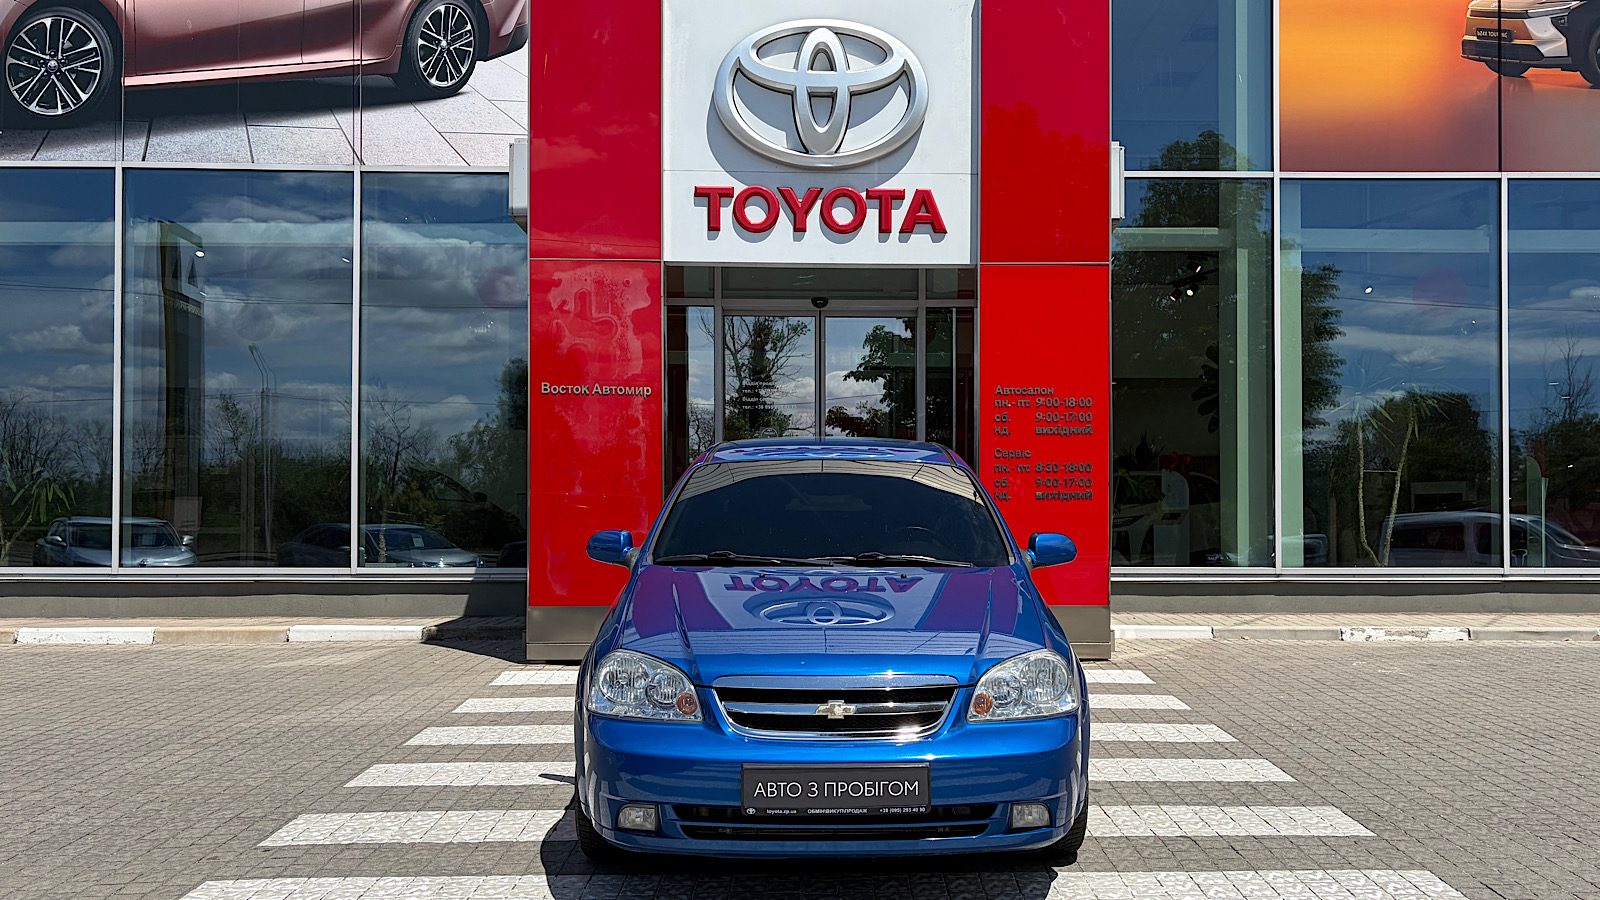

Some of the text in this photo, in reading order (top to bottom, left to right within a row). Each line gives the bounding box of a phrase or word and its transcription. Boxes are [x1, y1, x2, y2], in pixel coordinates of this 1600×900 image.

[694, 185, 948, 234] TOYOTA
[541, 382, 652, 399] Восток Автомир
[994, 384, 1055, 395] Автосалон
[1035, 397, 1093, 408] 9:00-18:00
[994, 411, 1093, 422] сб. 9:00-17:00
[994, 424, 1093, 436] нд. вихідний
[994, 448, 1031, 460] Сервіс
[1035, 462, 1093, 473] 8:30-18:00
[994, 477, 1093, 488] сб. 9:00-17:00
[1035, 489, 1093, 501] вихідний
[753, 781, 919, 798] АВТО З ПРОБІГОМ
